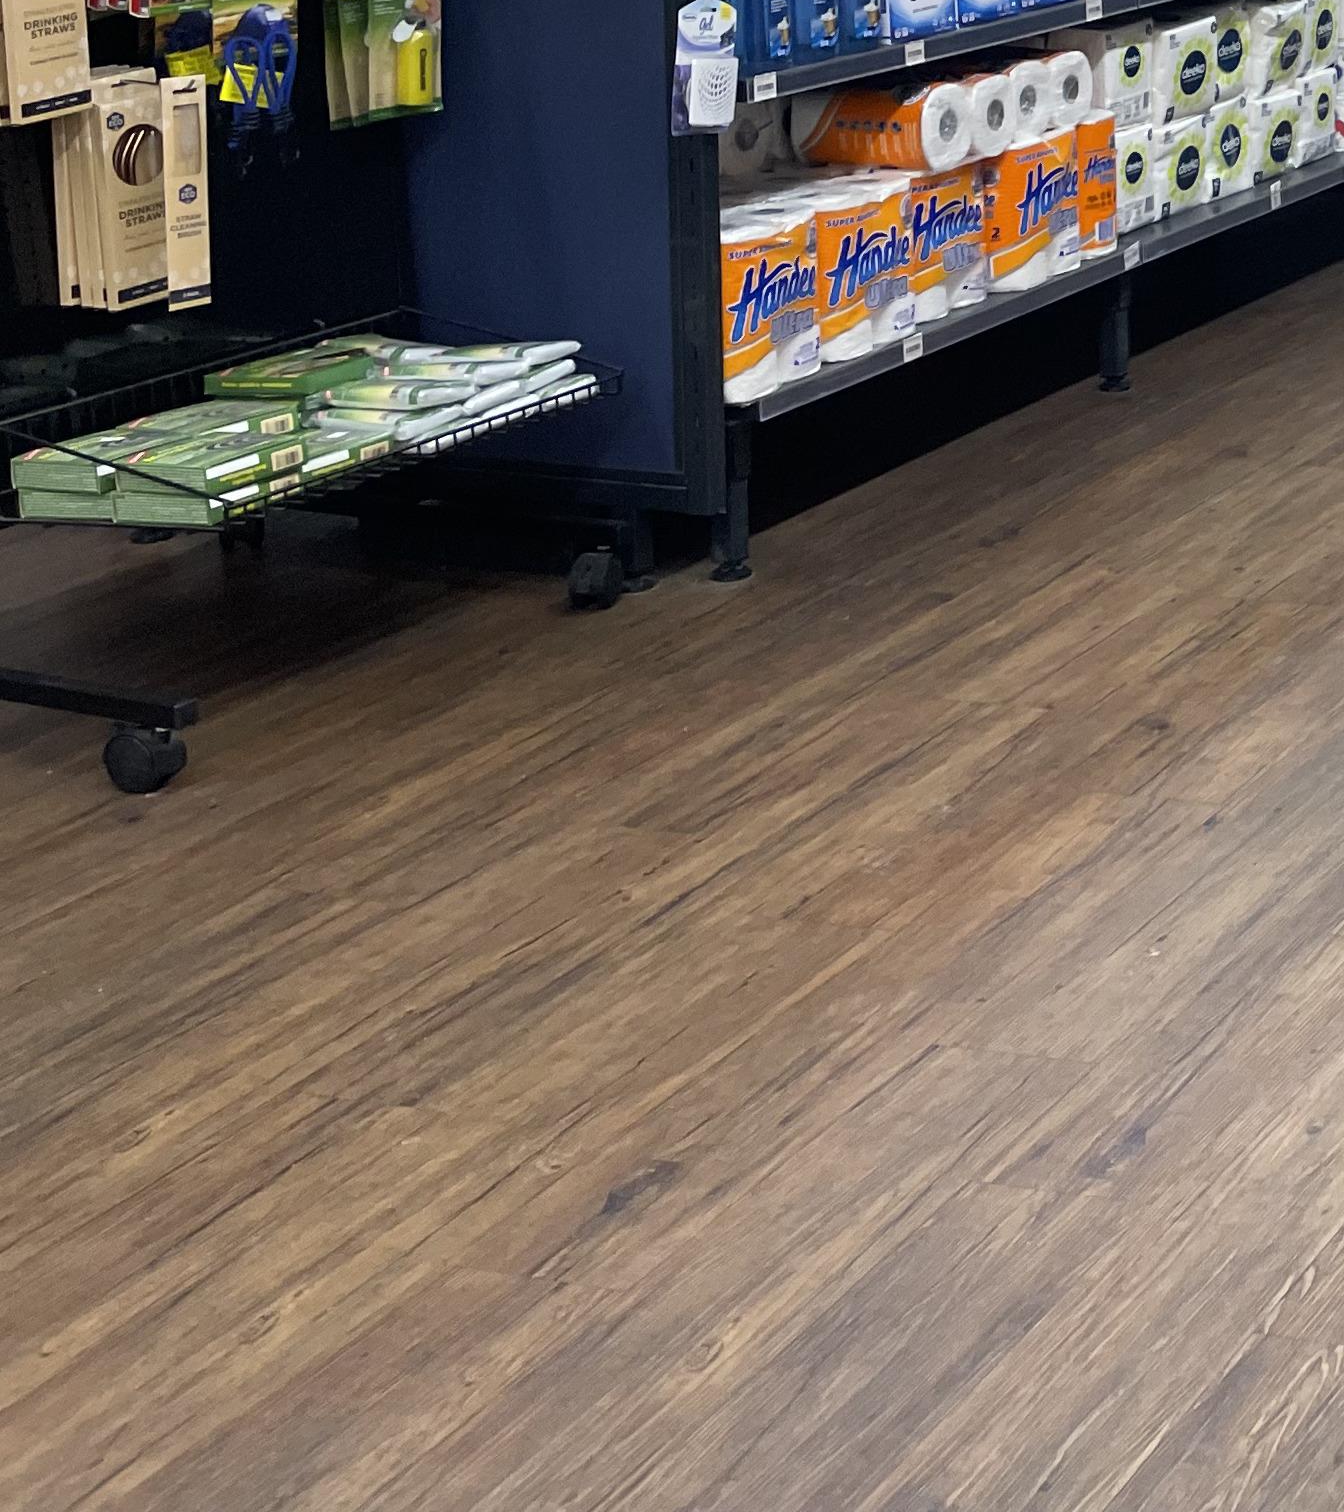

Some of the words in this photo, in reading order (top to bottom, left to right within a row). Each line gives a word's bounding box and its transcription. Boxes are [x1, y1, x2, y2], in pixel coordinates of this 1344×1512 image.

[24, 11, 79, 31] DRINKING
[31, 23, 76, 40] STRAWS
[118, 201, 165, 221] DRINKIN
[825, 215, 856, 228] SUPER
[1018, 162, 1079, 237] Handee
[911, 195, 983, 264] Handee
[826, 226, 911, 310] Handee
[727, 254, 816, 344] Handee
